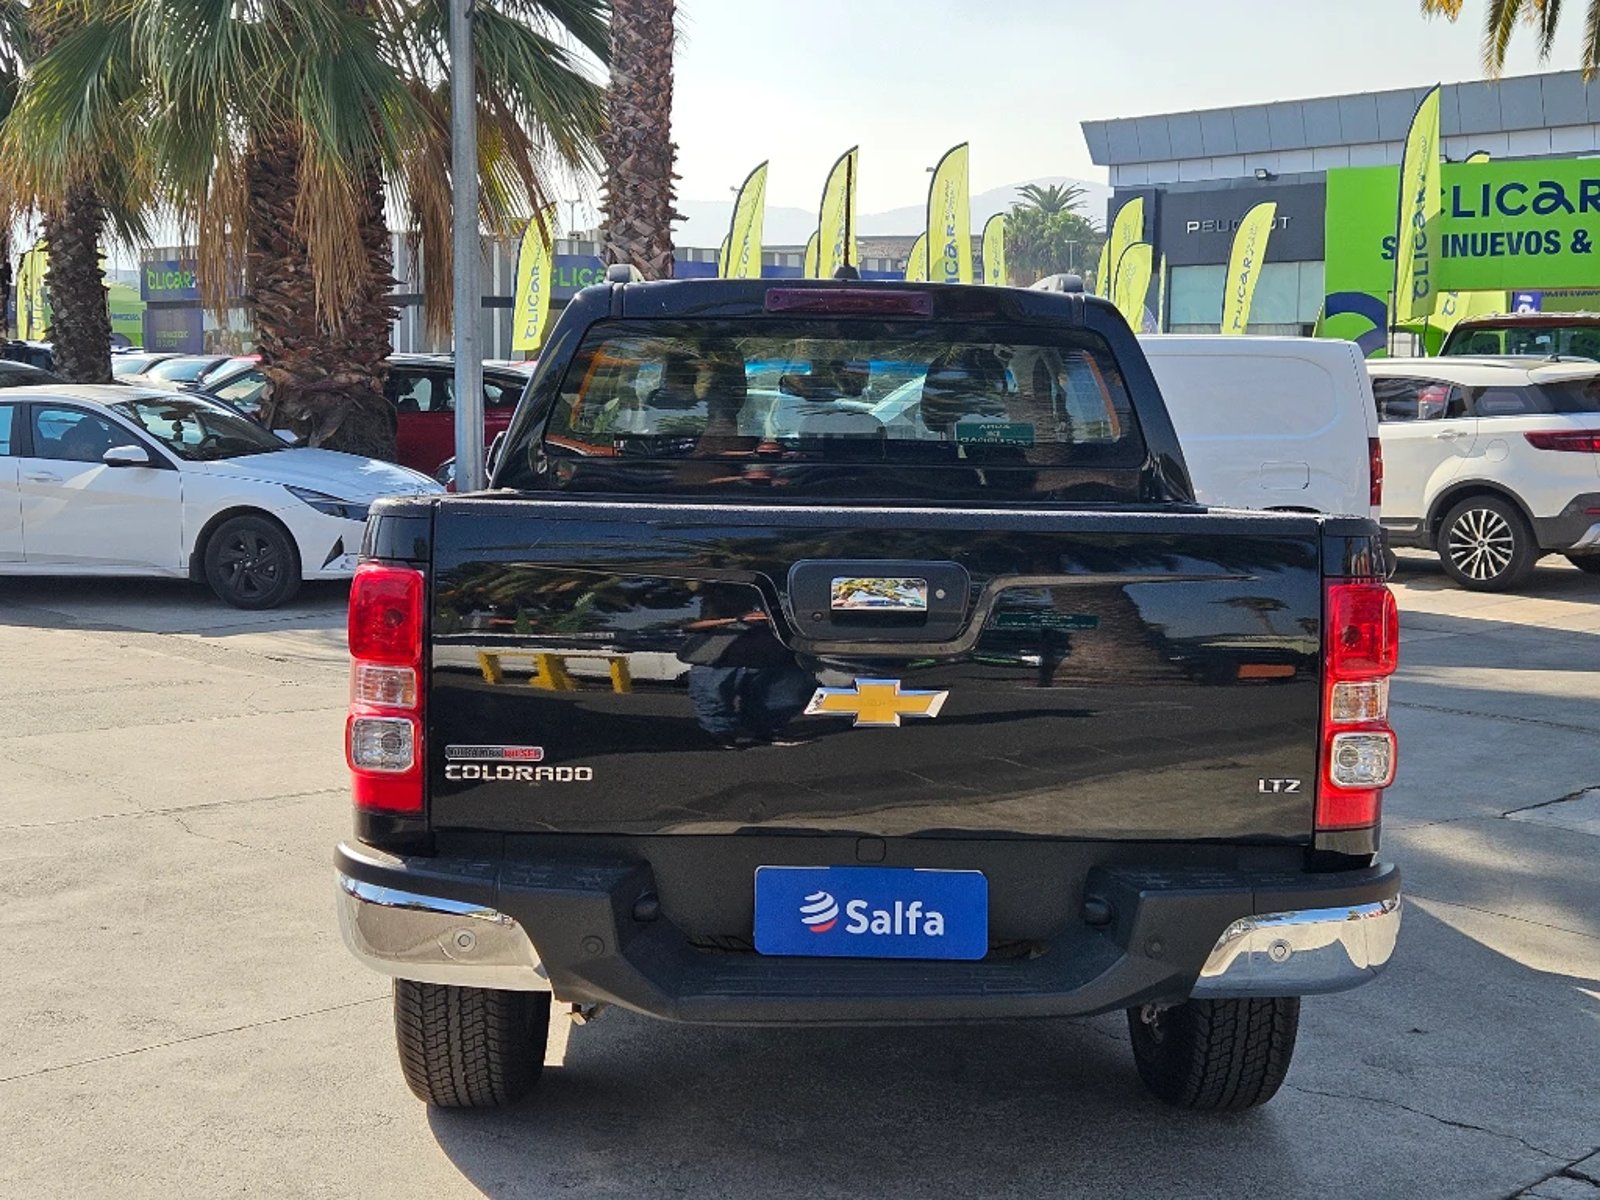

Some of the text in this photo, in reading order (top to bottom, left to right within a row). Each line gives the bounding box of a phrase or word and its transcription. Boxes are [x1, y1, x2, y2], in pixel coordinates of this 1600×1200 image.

[1440, 179, 1600, 218] LICAR
[1186, 216, 1291, 234] PEUT
[1381, 229, 1593, 260] SINUEVOS &
[524, 264, 541, 341] CLICAR
[445, 764, 593, 782] COLORADO
[1258, 779, 1301, 793] LTZ
[845, 899, 945, 936] Salfa
